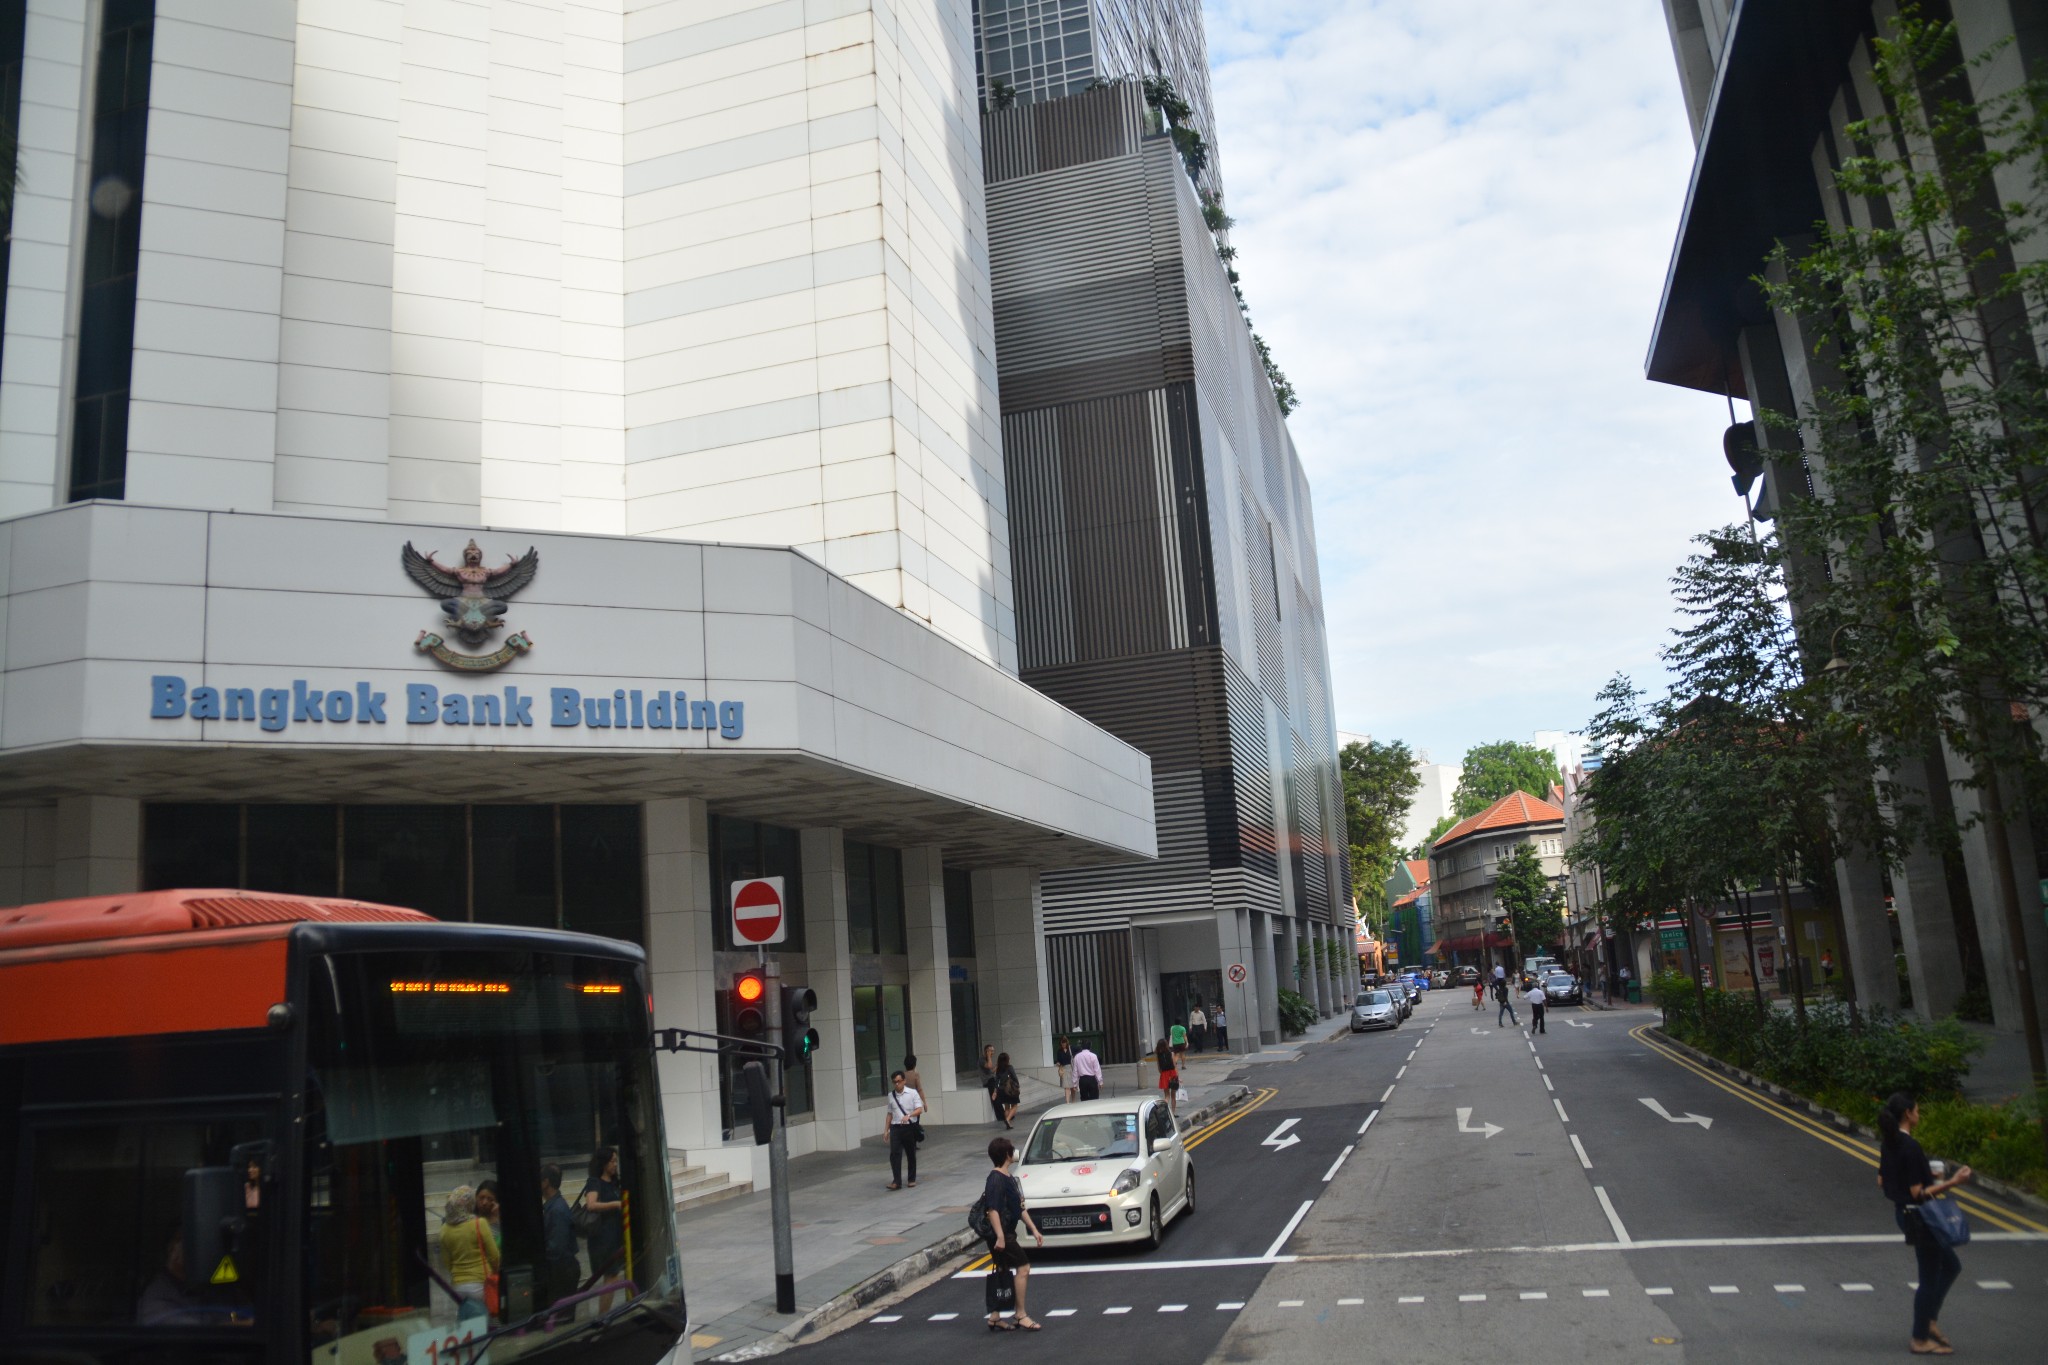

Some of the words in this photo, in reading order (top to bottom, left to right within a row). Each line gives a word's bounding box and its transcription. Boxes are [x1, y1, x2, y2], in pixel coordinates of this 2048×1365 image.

[151, 675, 387, 732] Bangkok
[406, 683, 533, 726] Bank
[551, 687, 745, 740] Building
